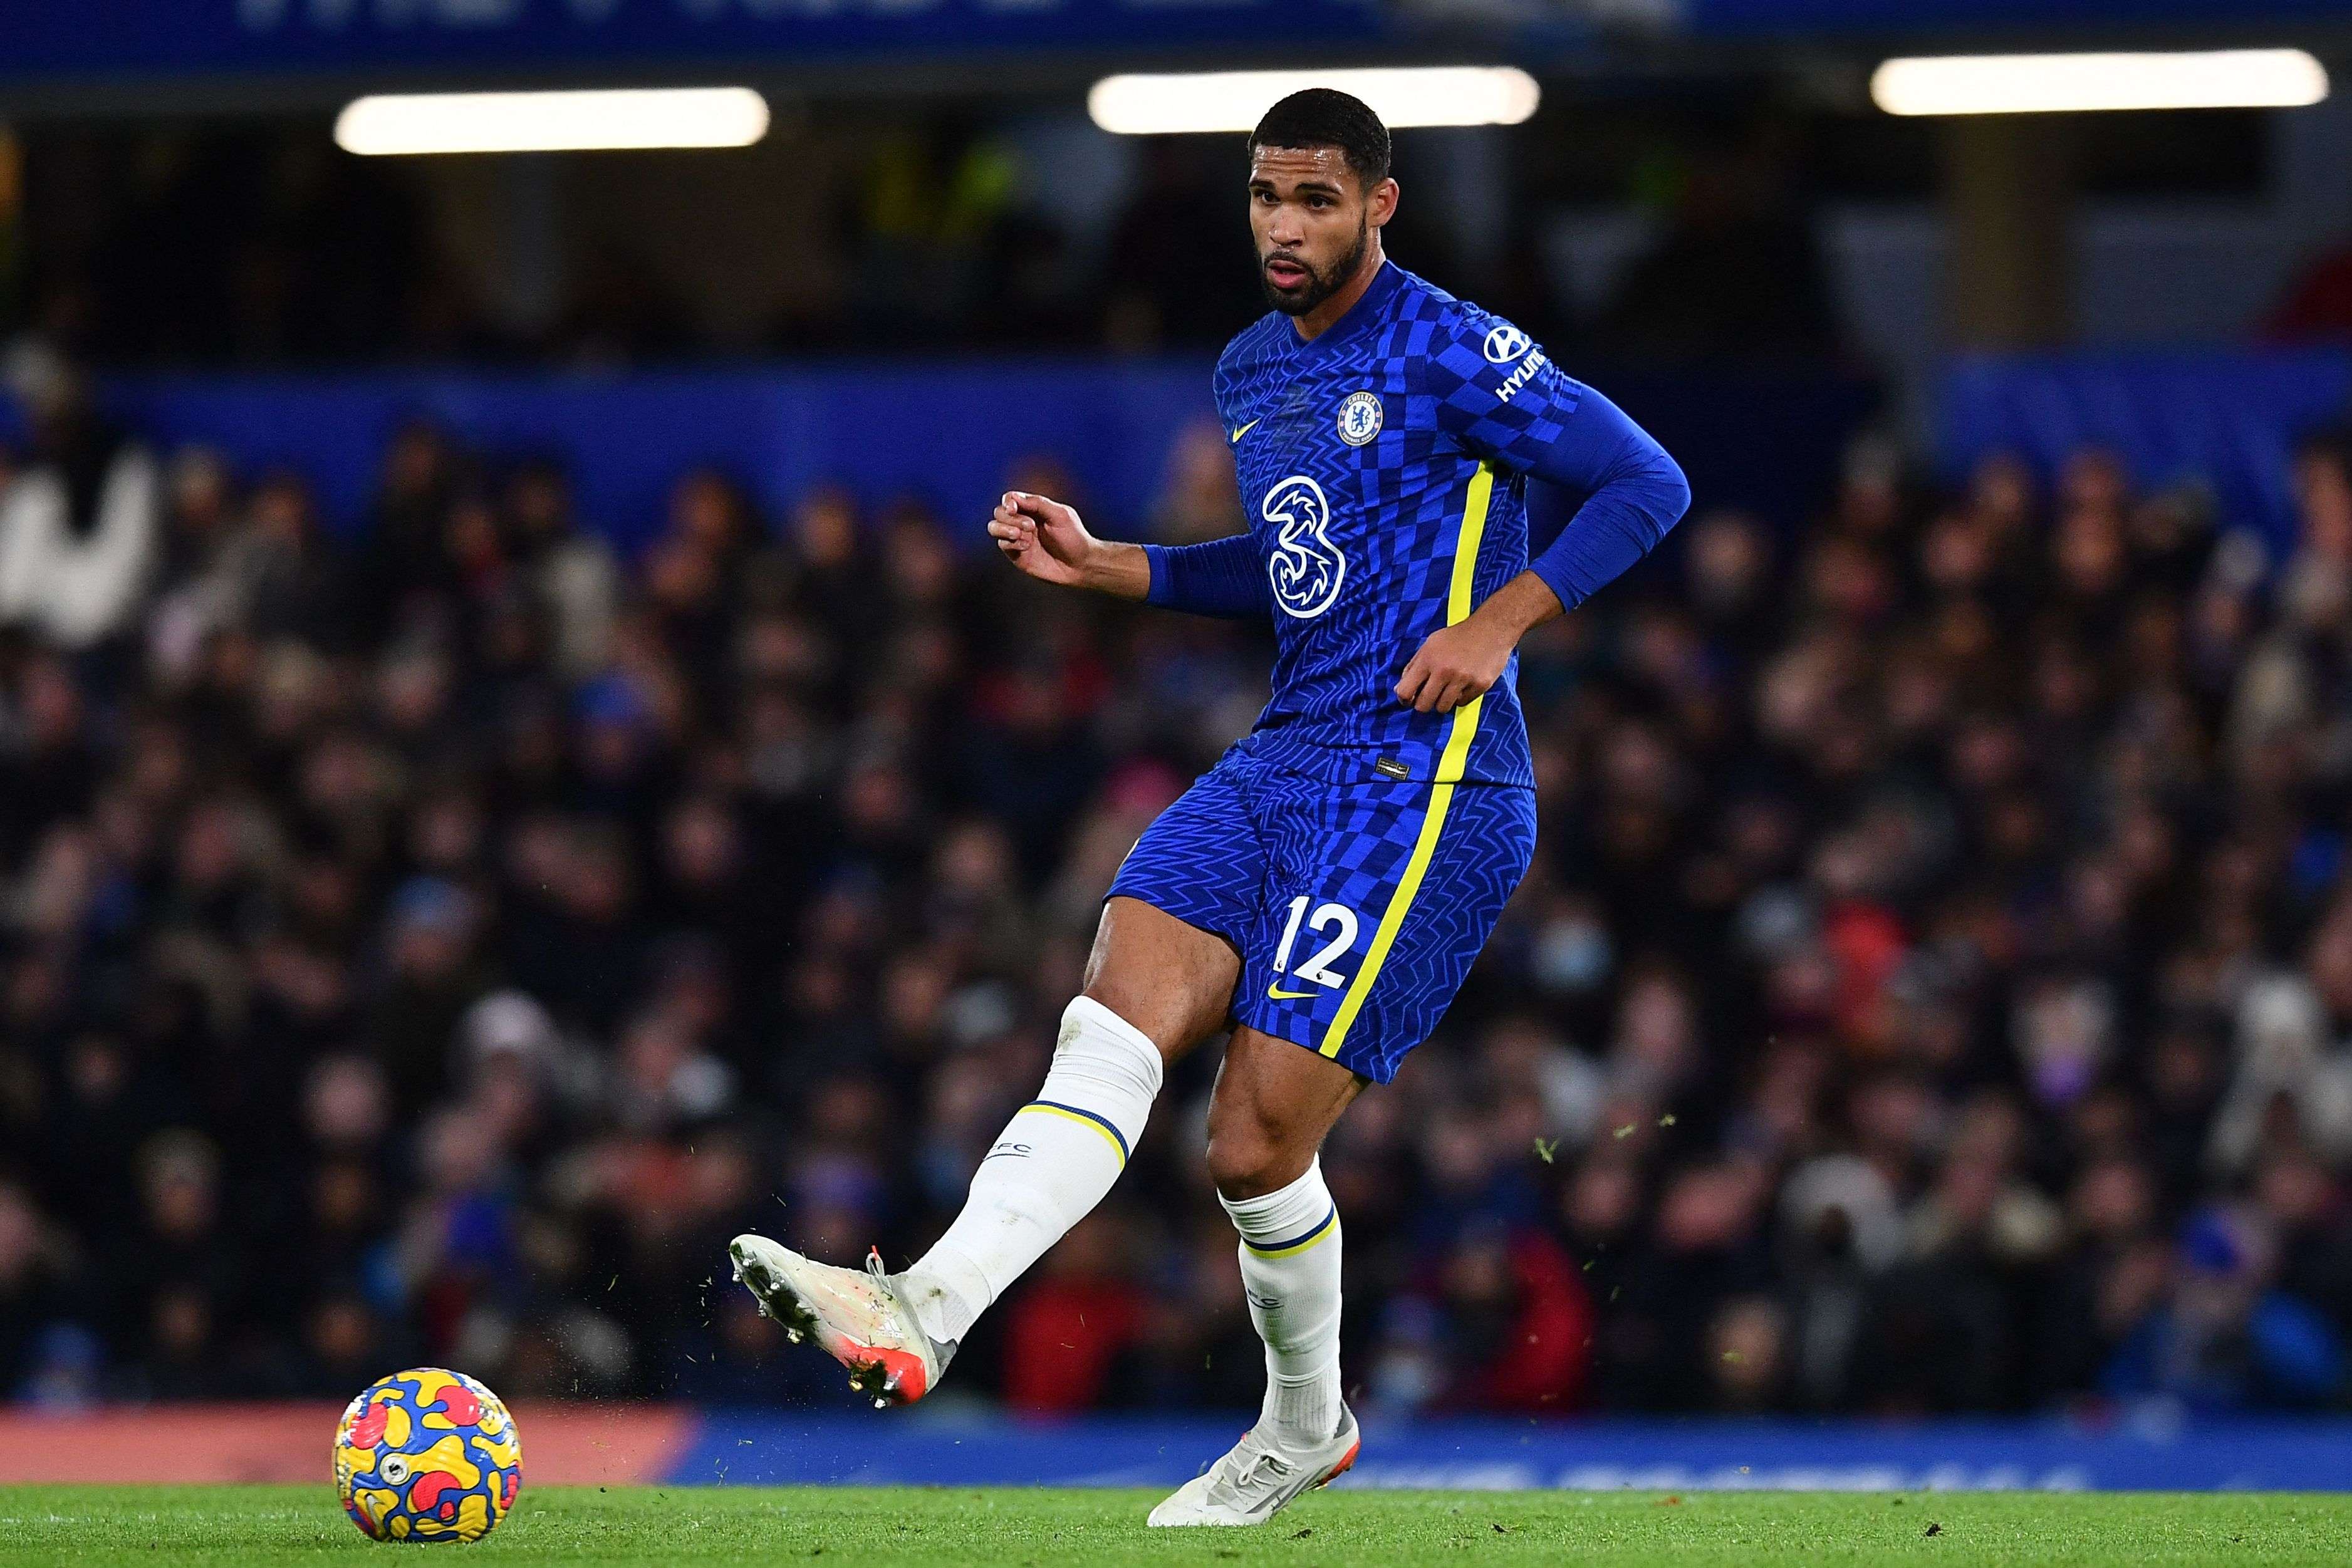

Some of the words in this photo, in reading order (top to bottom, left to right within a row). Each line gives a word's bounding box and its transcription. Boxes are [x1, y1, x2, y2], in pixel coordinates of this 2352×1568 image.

[1348, 394, 1376, 407] CHELSEA
[1273, 896, 1358, 989] 12
[990, 1143, 1032, 1153] FC
